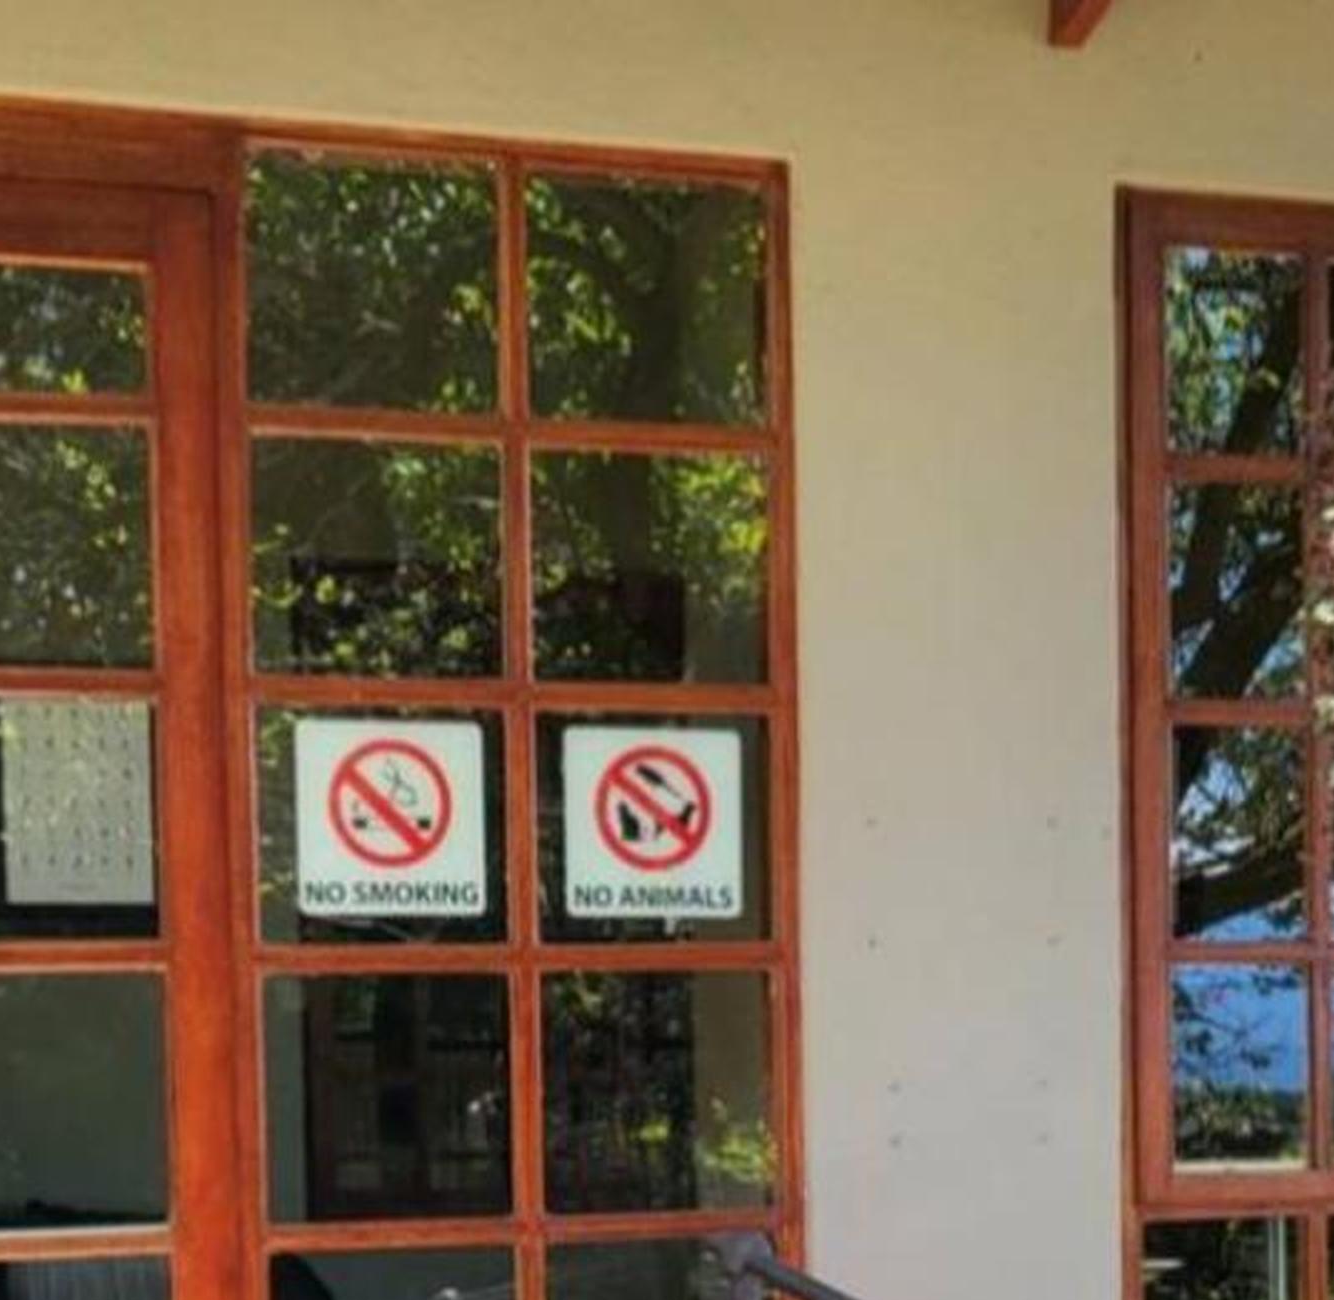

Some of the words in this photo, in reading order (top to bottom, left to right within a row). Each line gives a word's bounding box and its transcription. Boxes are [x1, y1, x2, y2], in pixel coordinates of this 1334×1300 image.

[305, 880, 347, 904] NO
[352, 880, 479, 905] SMOKING
[574, 884, 613, 908] NO
[619, 884, 732, 909] ANIMALS
